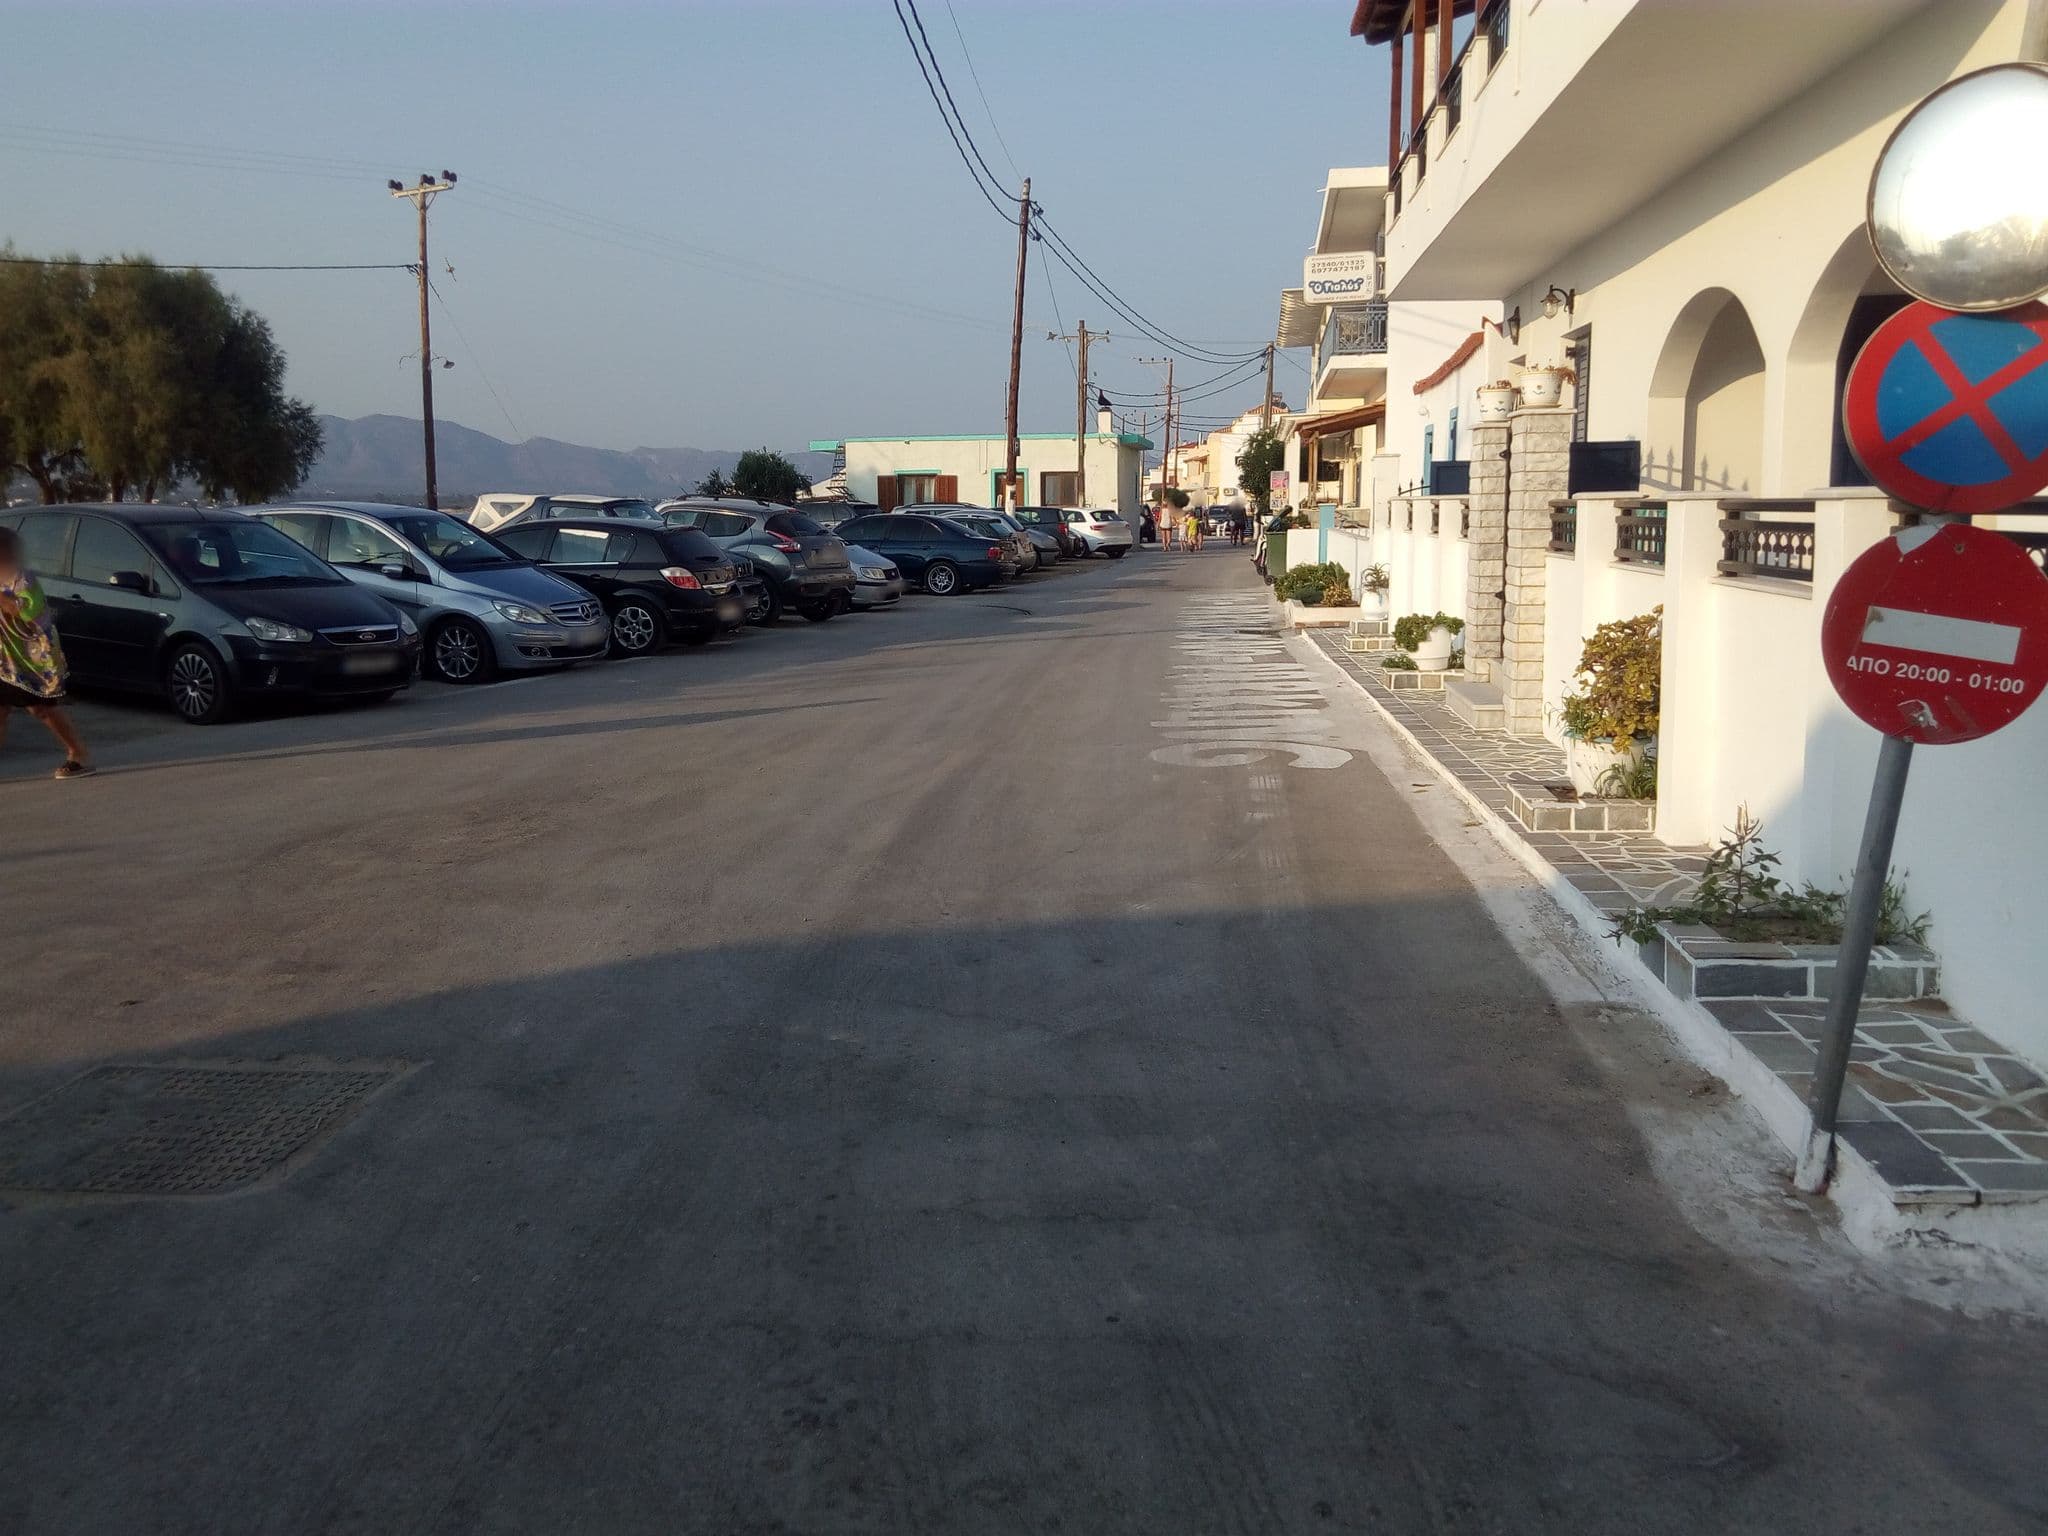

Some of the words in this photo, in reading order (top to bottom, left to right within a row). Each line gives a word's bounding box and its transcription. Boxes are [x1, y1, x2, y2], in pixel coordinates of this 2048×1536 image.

[1846, 655, 1890, 675] ΑΠΟ
[1895, 662, 1951, 684] 20:00
[1968, 673, 2025, 695] 01:00
